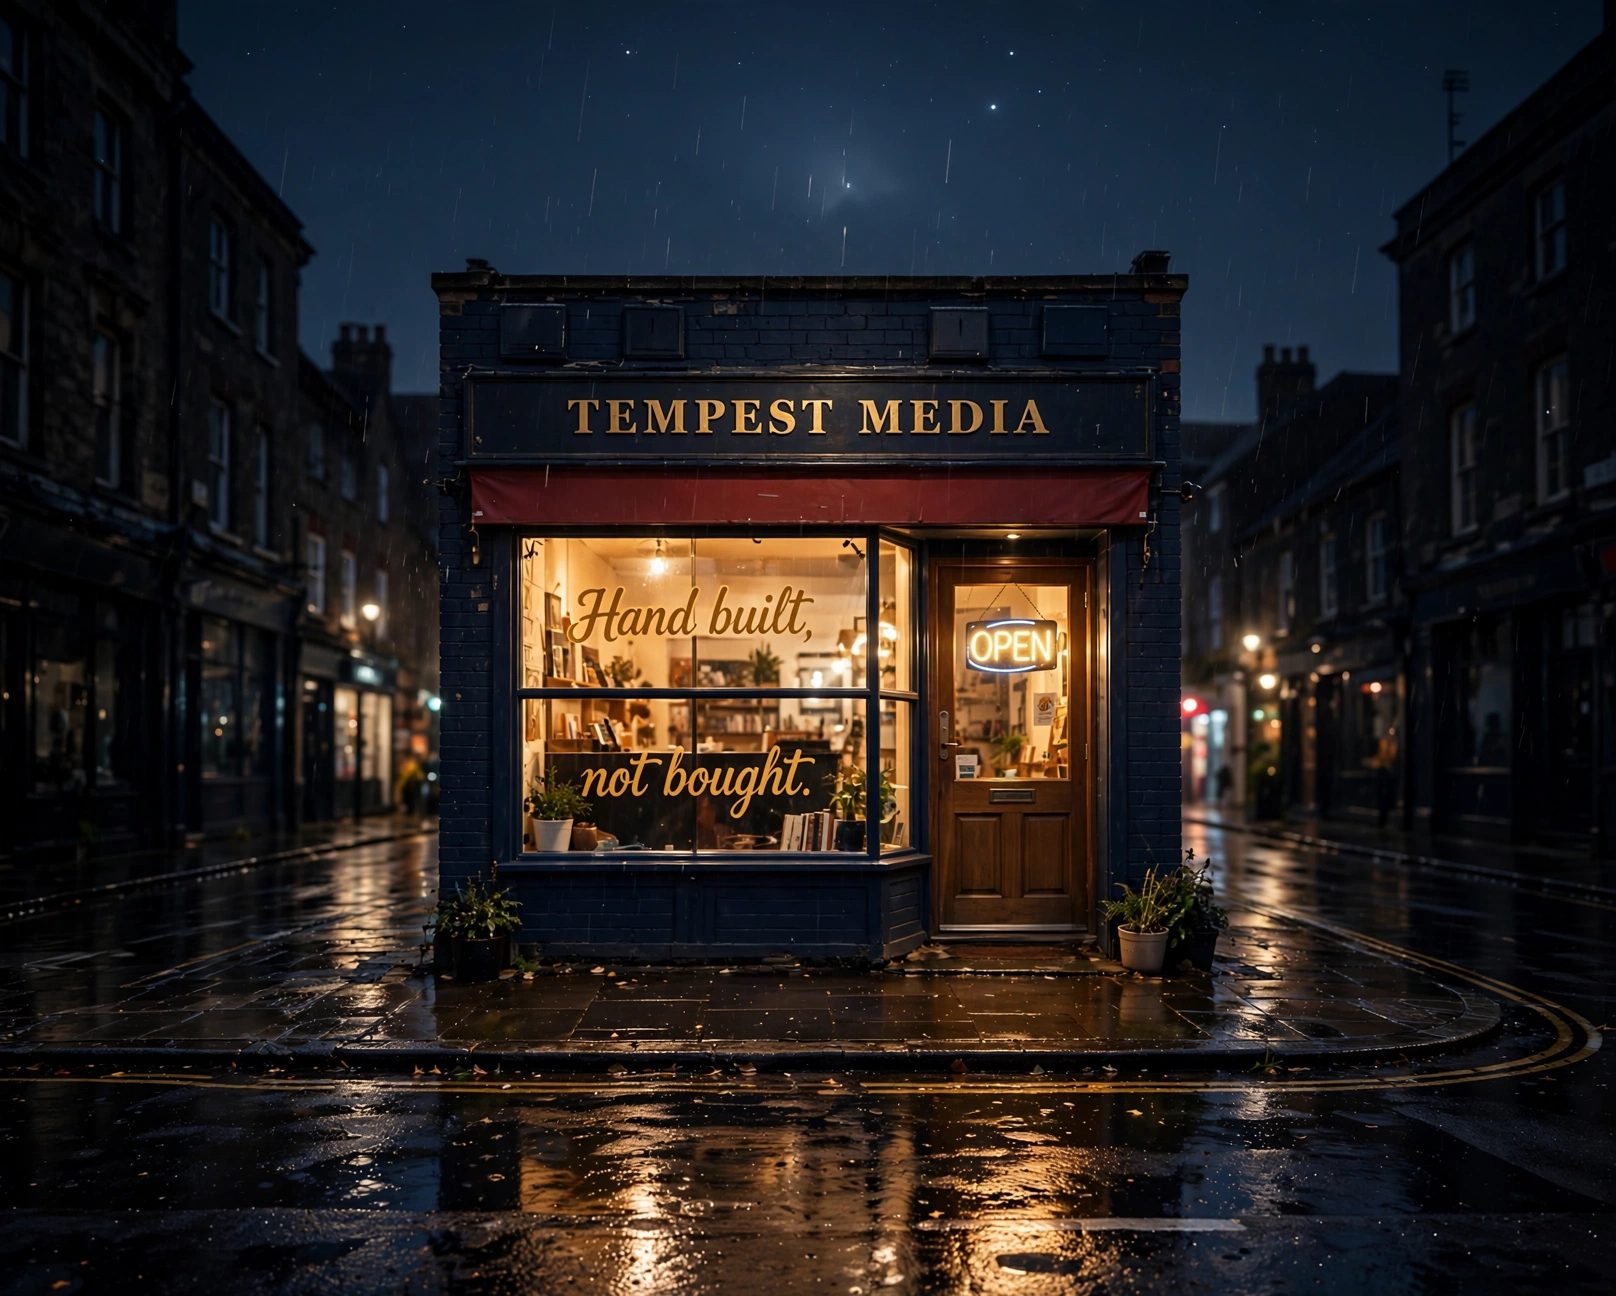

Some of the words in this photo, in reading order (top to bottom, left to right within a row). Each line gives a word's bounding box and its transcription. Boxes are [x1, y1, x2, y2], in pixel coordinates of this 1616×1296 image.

[567, 399, 833, 435] TEMPEST
[858, 399, 1050, 435] MEDIA
[566, 586, 700, 644] Hand
[708, 585, 815, 643] built,
[970, 629, 1052, 663] OPEN
[580, 751, 663, 797] not
[662, 744, 816, 819] bought.
